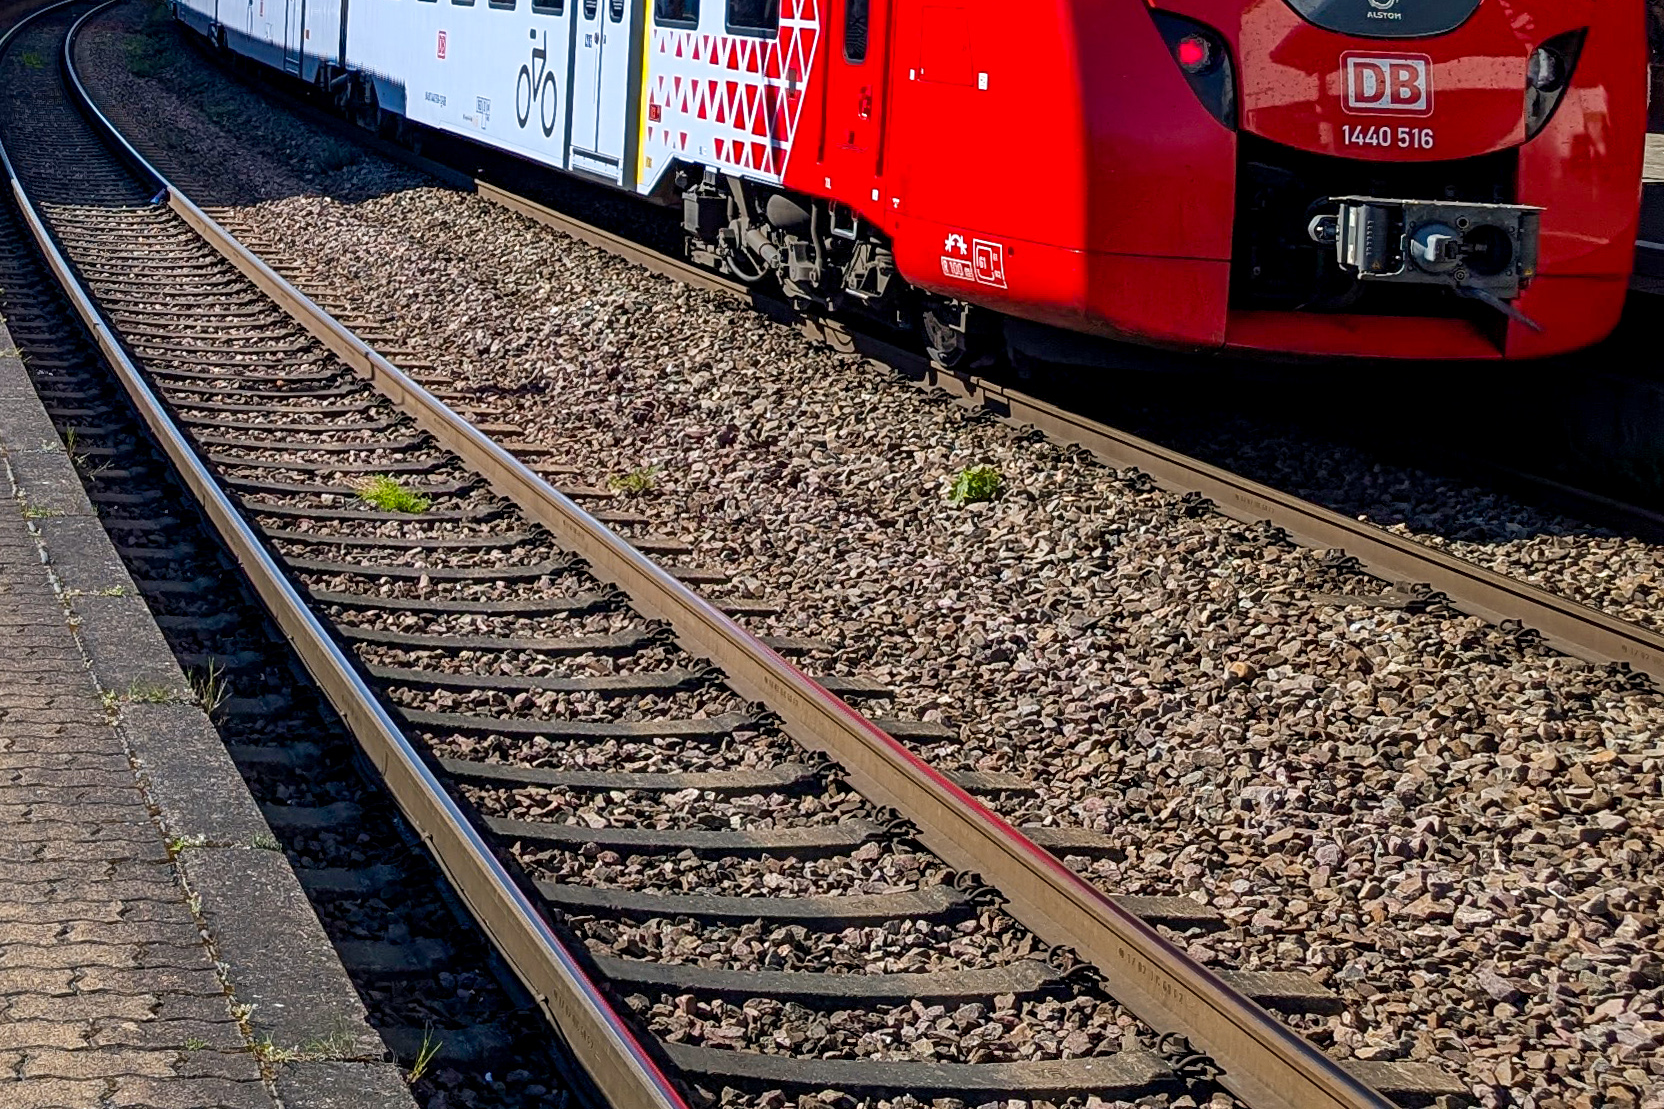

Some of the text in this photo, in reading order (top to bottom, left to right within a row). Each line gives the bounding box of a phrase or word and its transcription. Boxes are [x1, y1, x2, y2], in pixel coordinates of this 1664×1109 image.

[1367, 11, 1403, 21] ALSTOM
[1353, 61, 1423, 106] DB
[1342, 124, 1434, 149] 1440 516
